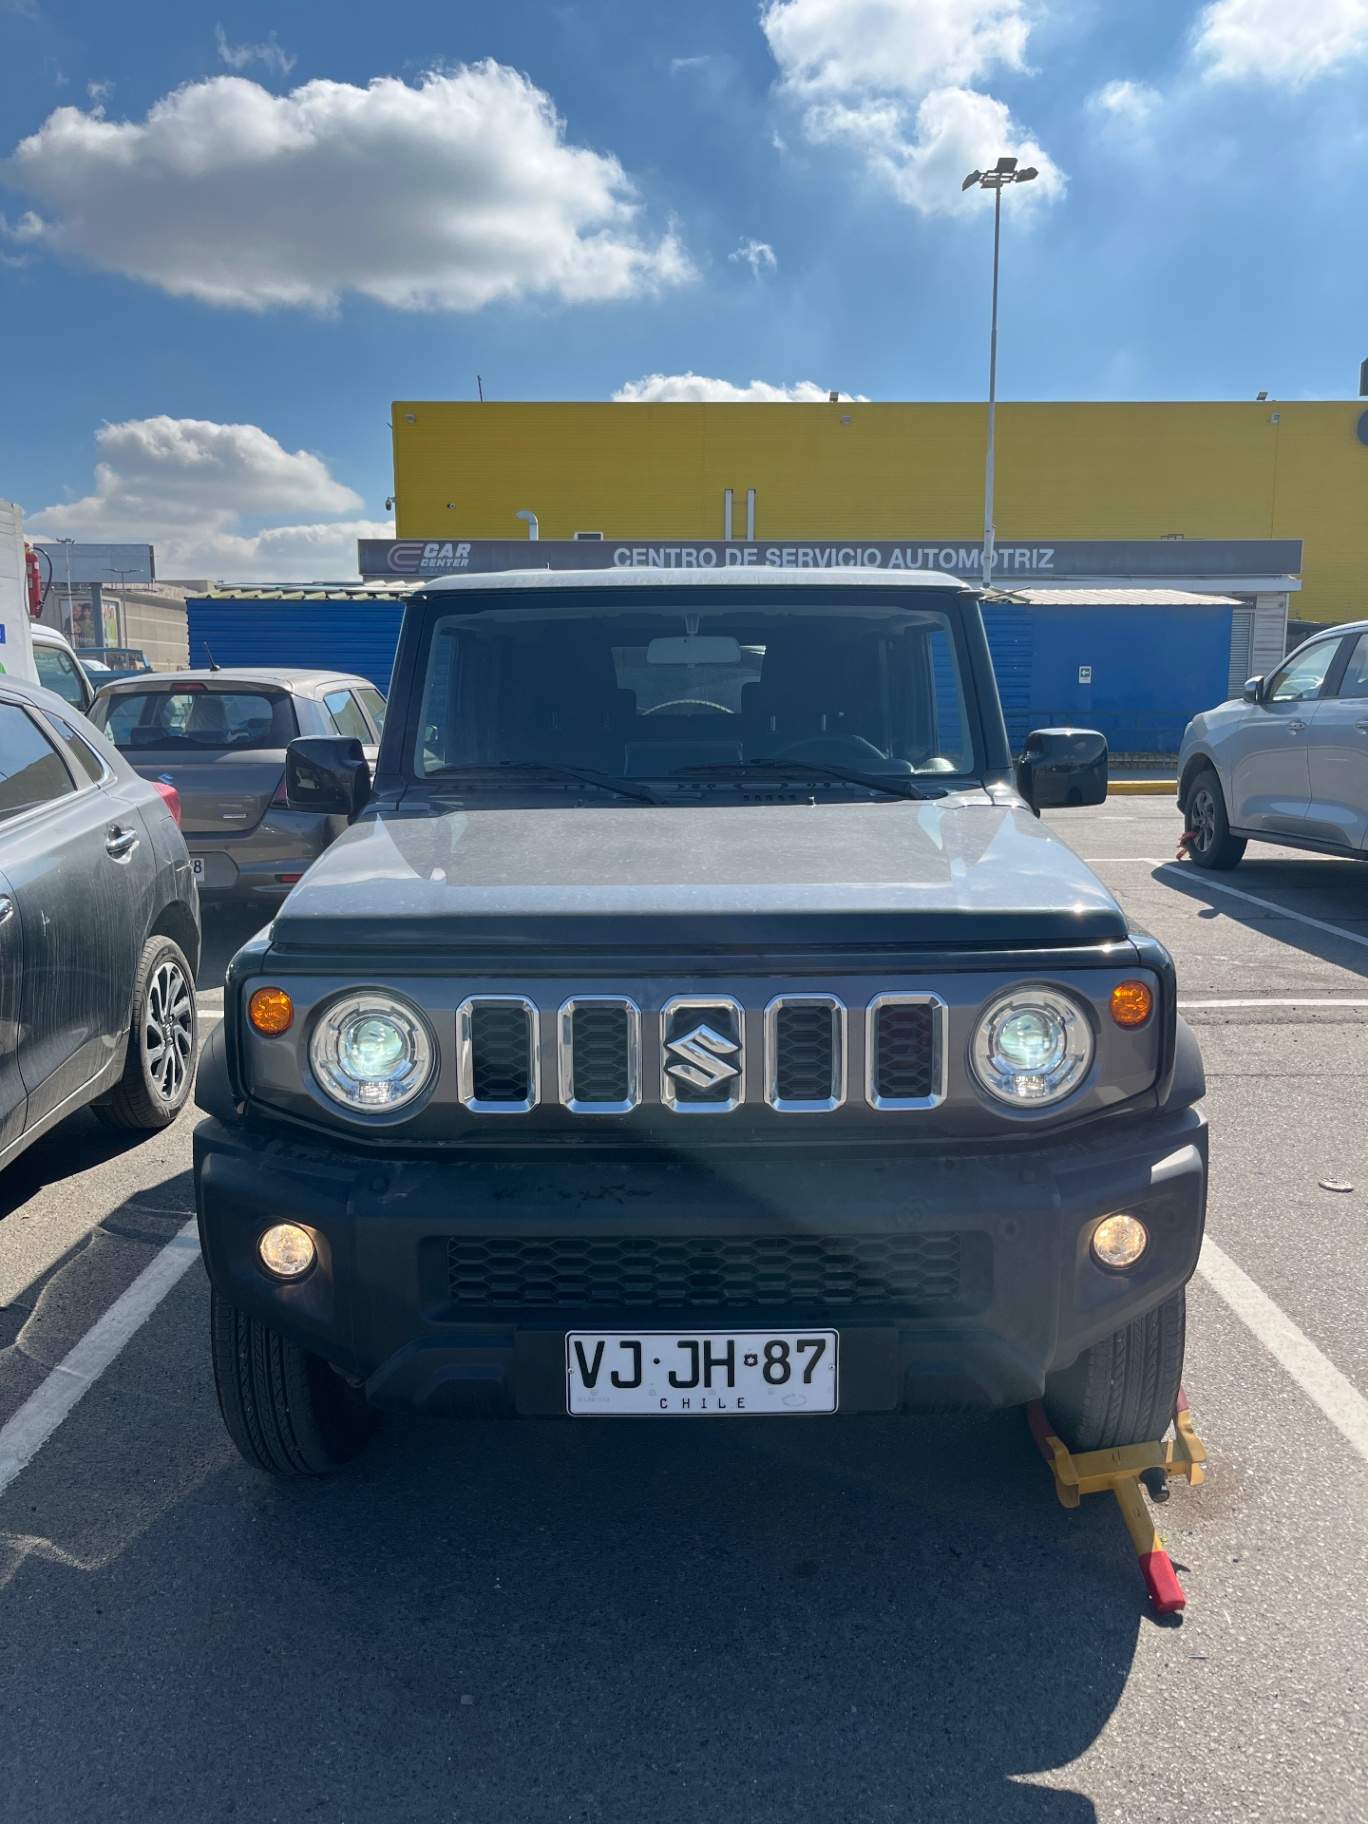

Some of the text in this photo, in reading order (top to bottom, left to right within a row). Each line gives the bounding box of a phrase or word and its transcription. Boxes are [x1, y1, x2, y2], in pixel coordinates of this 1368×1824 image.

[423, 543, 471, 557] CAR
[420, 558, 469, 567] CENTER
[613, 548, 717, 568] CENTRO
[725, 548, 757, 567] DE
[765, 548, 881, 568] SERVICIO
[659, 1397, 745, 1409] CHILE
